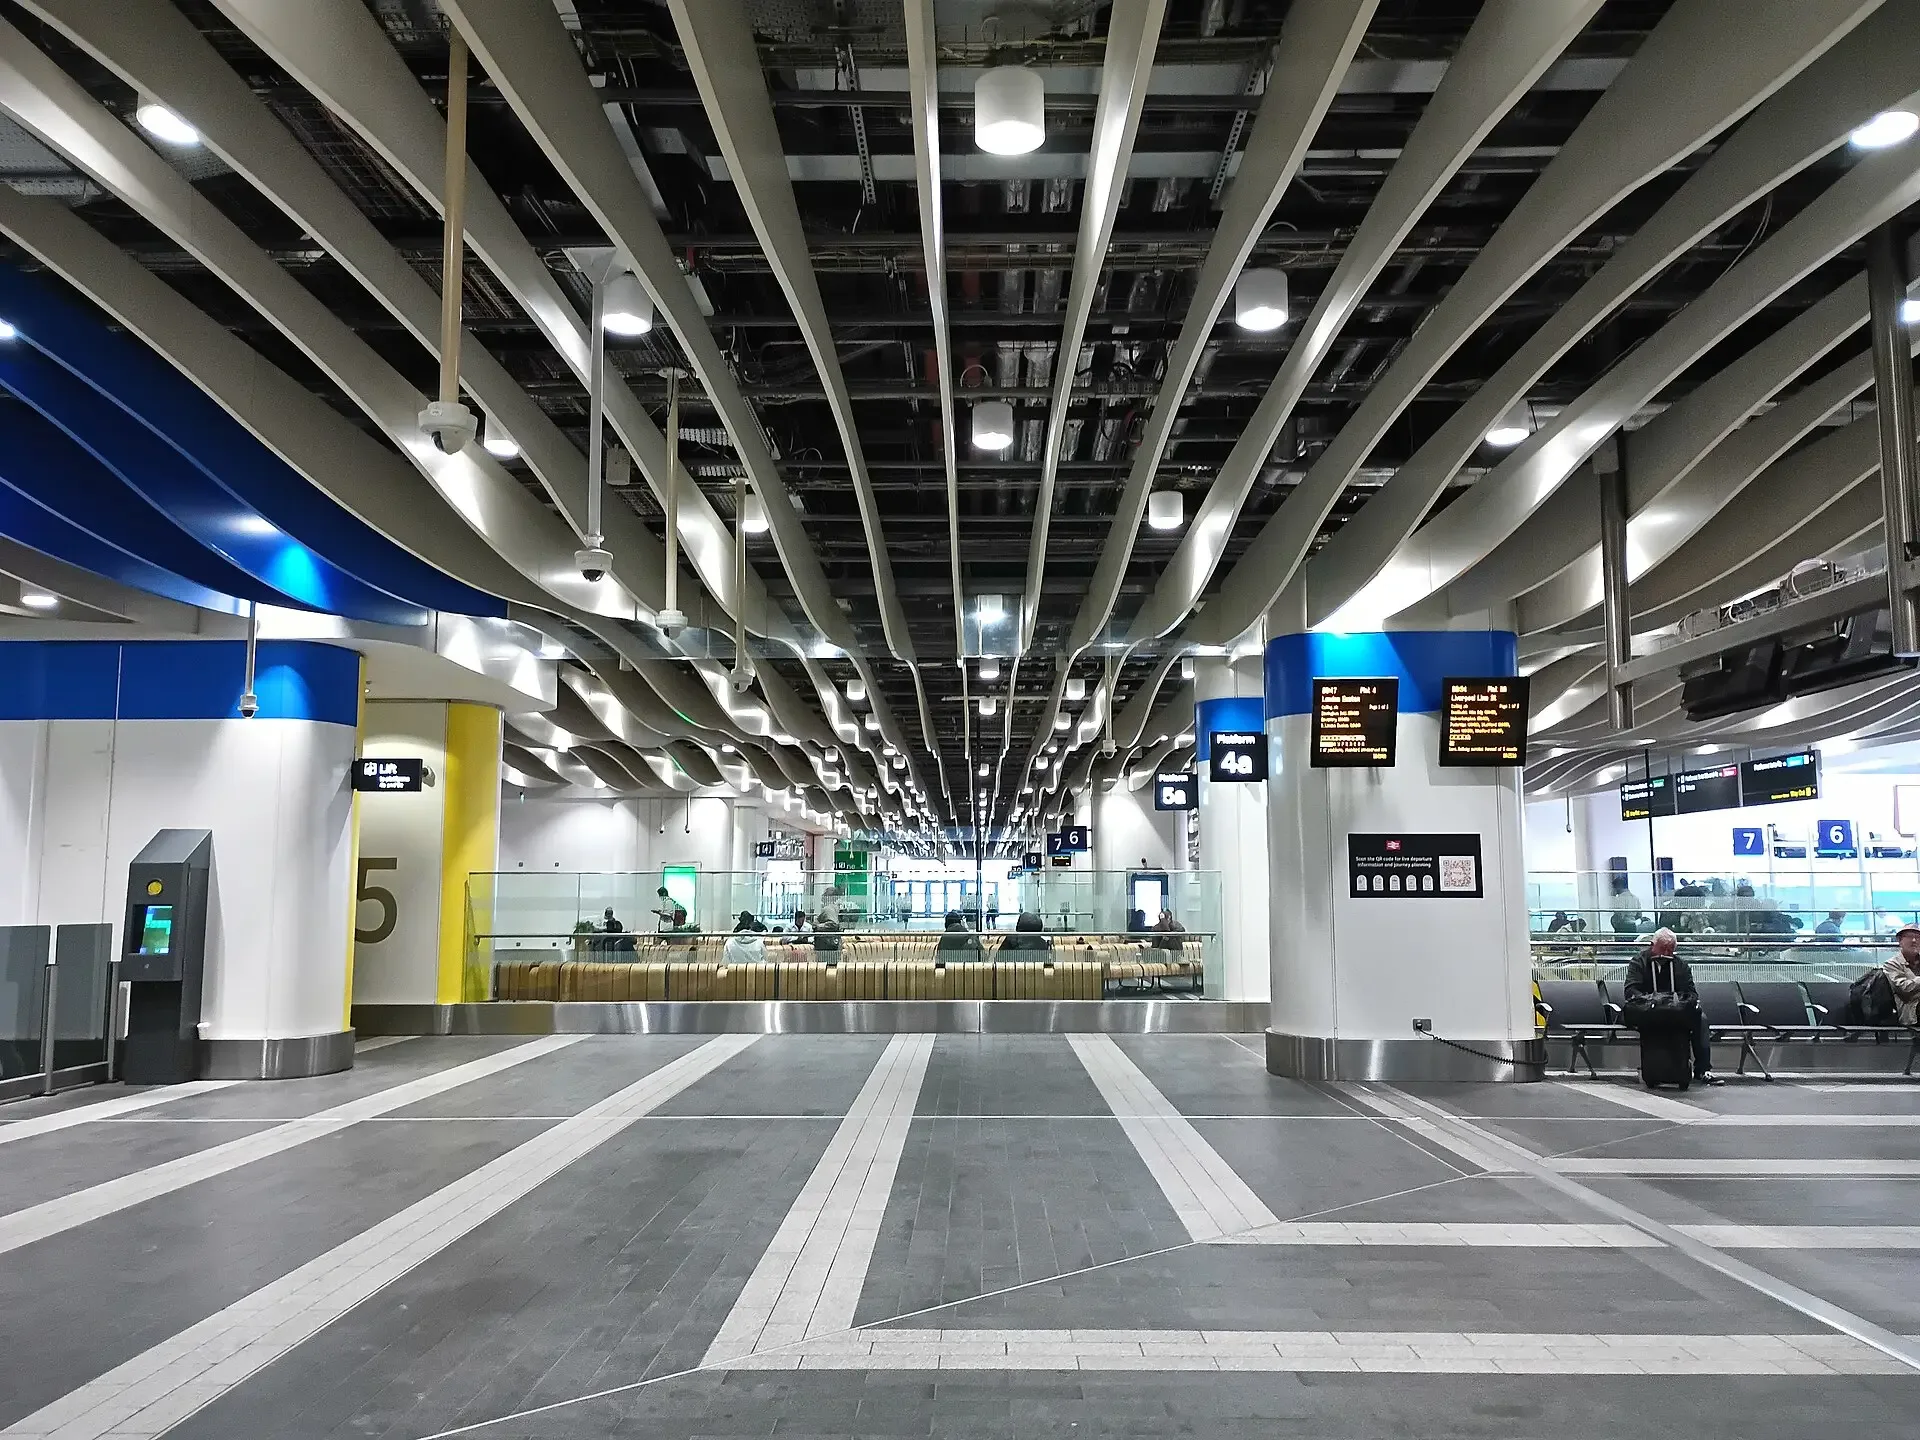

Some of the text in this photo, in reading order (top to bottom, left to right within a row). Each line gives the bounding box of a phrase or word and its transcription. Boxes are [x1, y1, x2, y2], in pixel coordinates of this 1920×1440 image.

[1451, 694, 1476, 702] Liverpool
[1216, 734, 1256, 745] Platform
[379, 763, 398, 775] Lift
[1220, 751, 1253, 774] 4a
[1158, 774, 1189, 782] Platform
[1162, 786, 1187, 805] 5a
[1069, 831, 1079, 845] 6
[1743, 832, 1756, 850] 7
[1829, 825, 1845, 844] 6
[1054, 838, 1062, 851] 7
[1030, 856, 1037, 865] 8
[354, 857, 398, 944] 5
